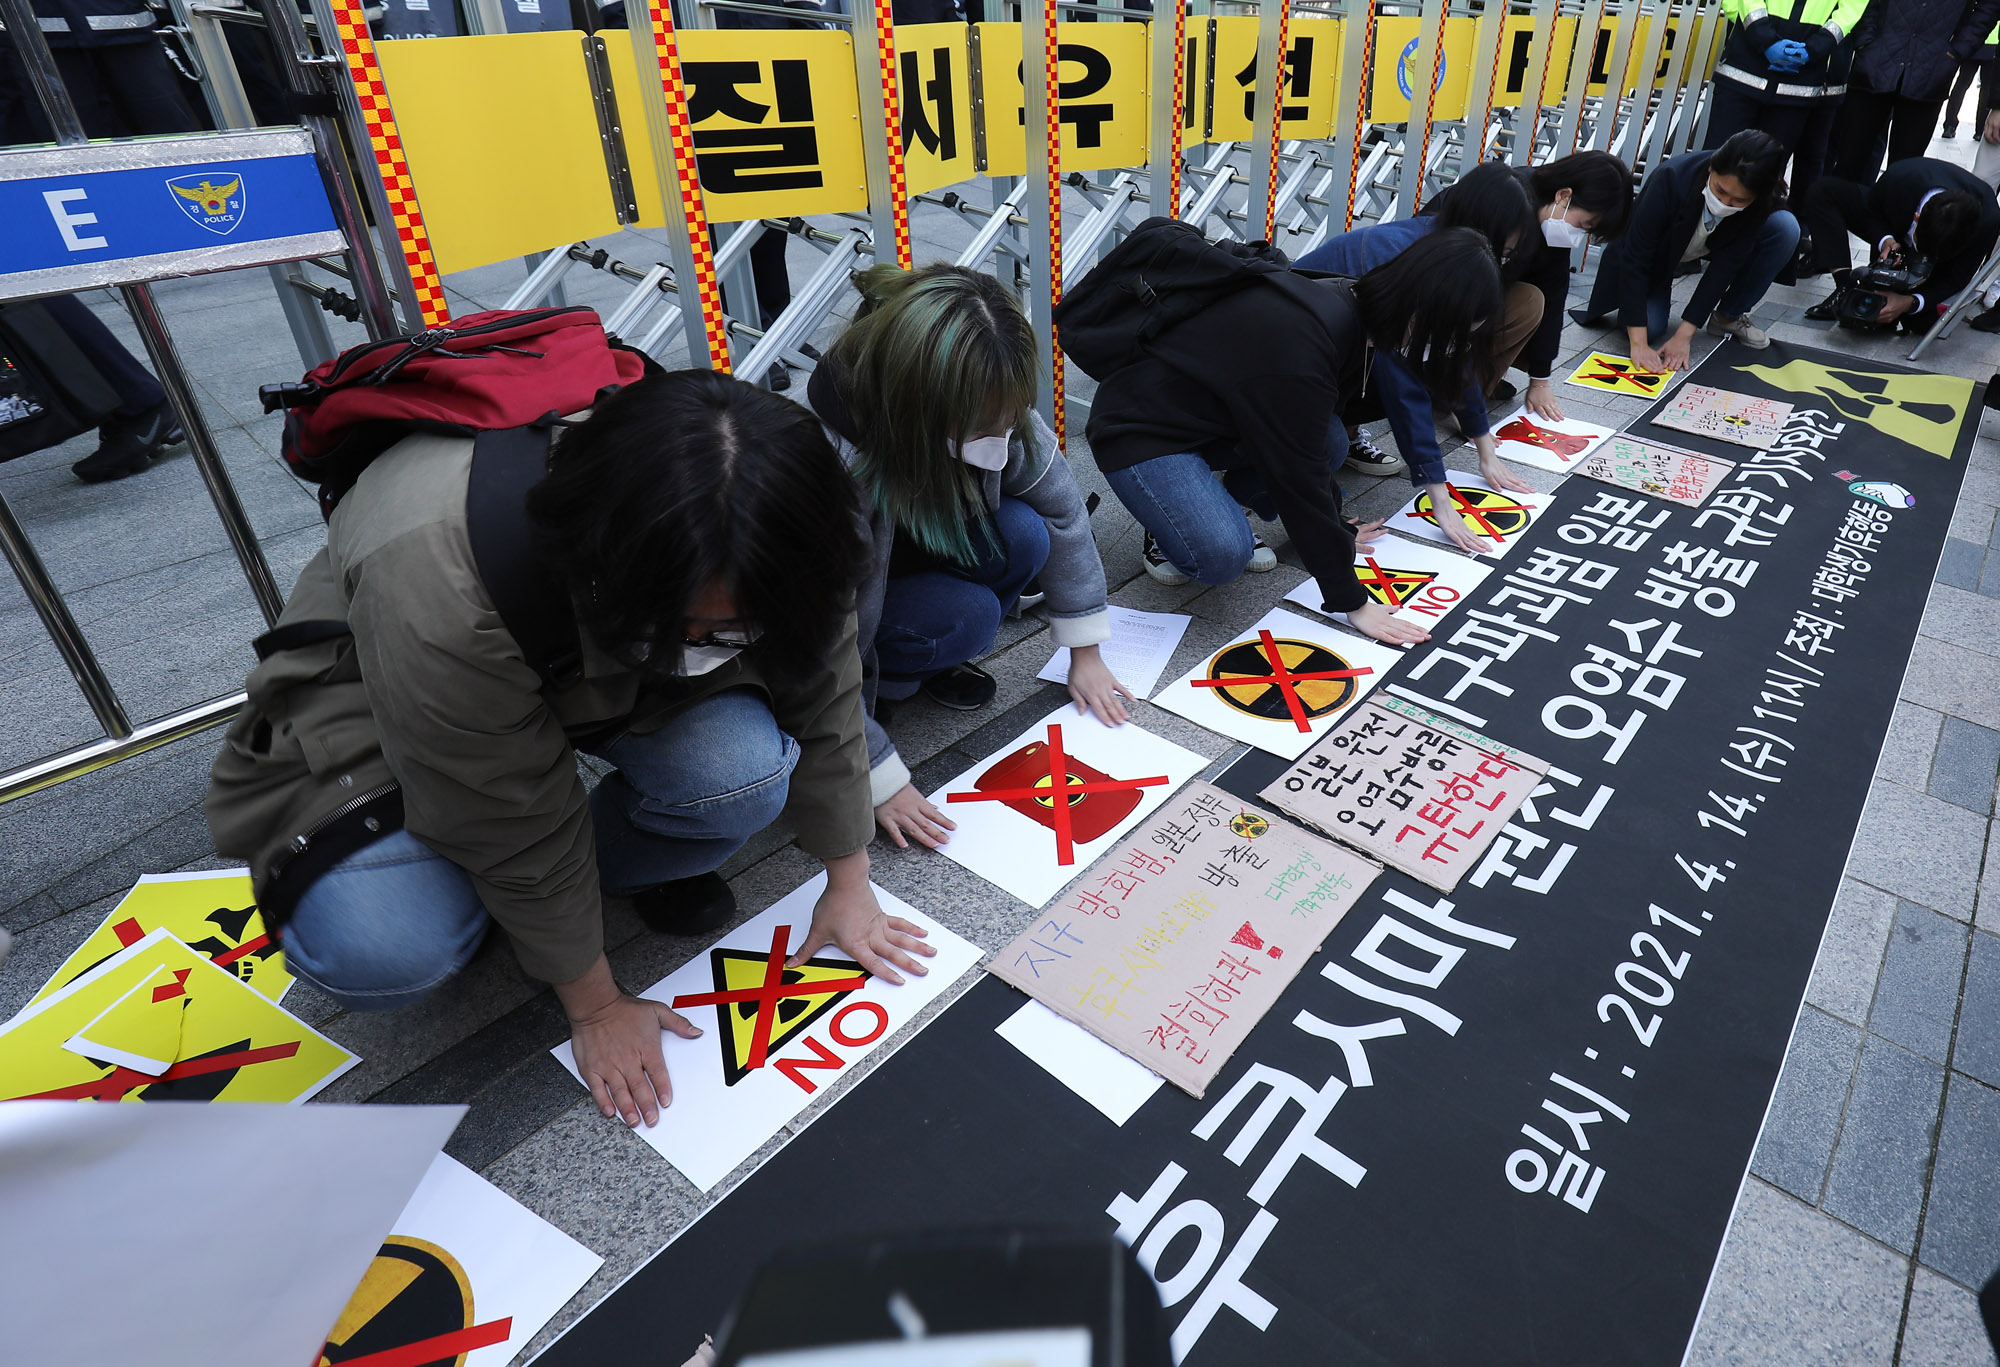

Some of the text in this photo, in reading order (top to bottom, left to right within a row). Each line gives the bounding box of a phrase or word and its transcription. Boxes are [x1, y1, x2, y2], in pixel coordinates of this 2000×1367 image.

[42, 187, 108, 252] E
[203, 214, 236, 224] POLICE
[1587, 457, 1613, 478] 인류의
[1735, 409, 1847, 488] 기자회견
[1557, 491, 1672, 552] 일본
[1691, 486, 1795, 547] 규탄
[1409, 586, 1460, 617] NO
[1634, 538, 1760, 619] 방출
[1541, 617, 1704, 765] 오염수
[1285, 712, 1409, 797] 일본 원전
[1395, 751, 1521, 864] 규탄한다
[1197, 844, 1270, 889] 방출
[1504, 1071, 1631, 1214] 일시
[1597, 902, 1714, 1048] 2021.
[1674, 852, 1737, 893] 4.
[1811, 500, 1894, 603] 대학생기후행동
[1014, 920, 1084, 979] 지구
[772, 1001, 889, 1095] NO
